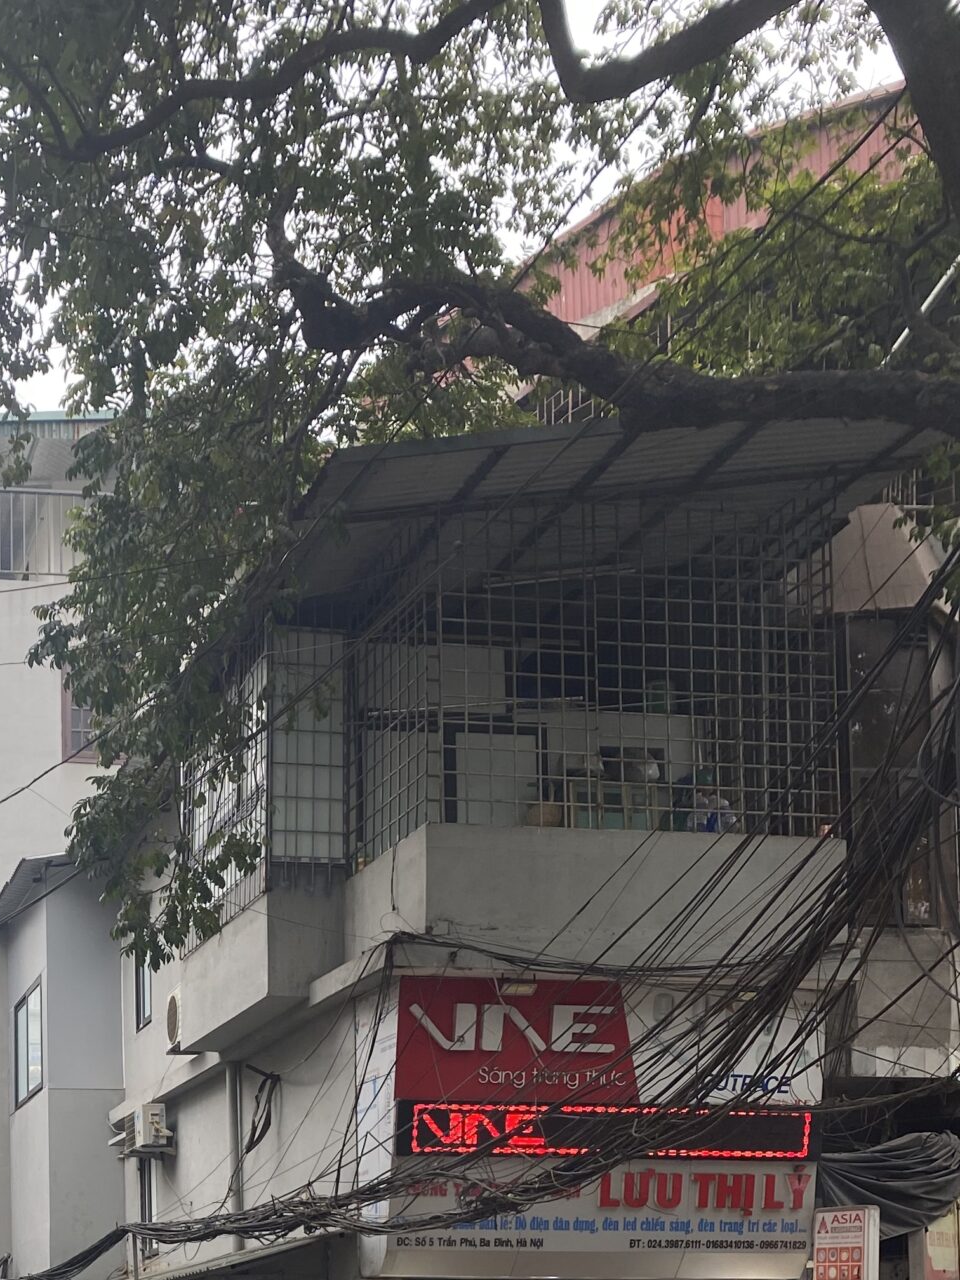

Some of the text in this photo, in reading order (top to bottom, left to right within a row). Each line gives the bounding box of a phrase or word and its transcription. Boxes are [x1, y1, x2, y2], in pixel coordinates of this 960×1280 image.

[478, 1065, 526, 1089] Sáng
[599, 1164, 812, 1216] LƯU THỊ LÝ
[530, 1216, 549, 1232] điện
[553, 1217, 570, 1231] dân
[573, 1217, 598, 1234] dụng,
[602, 1217, 619, 1231] đèn
[641, 1216, 665, 1232] chiếu
[669, 1219, 694, 1235] sáng,
[698, 1218, 715, 1232] đèn
[720, 1219, 744, 1235] trang
[762, 1219, 777, 1232] các
[831, 1213, 862, 1224] ASIA
[428, 1237, 434, 1246] 5
[480, 1238, 490, 1247] Ba
[530, 1238, 544, 1249] Nội
